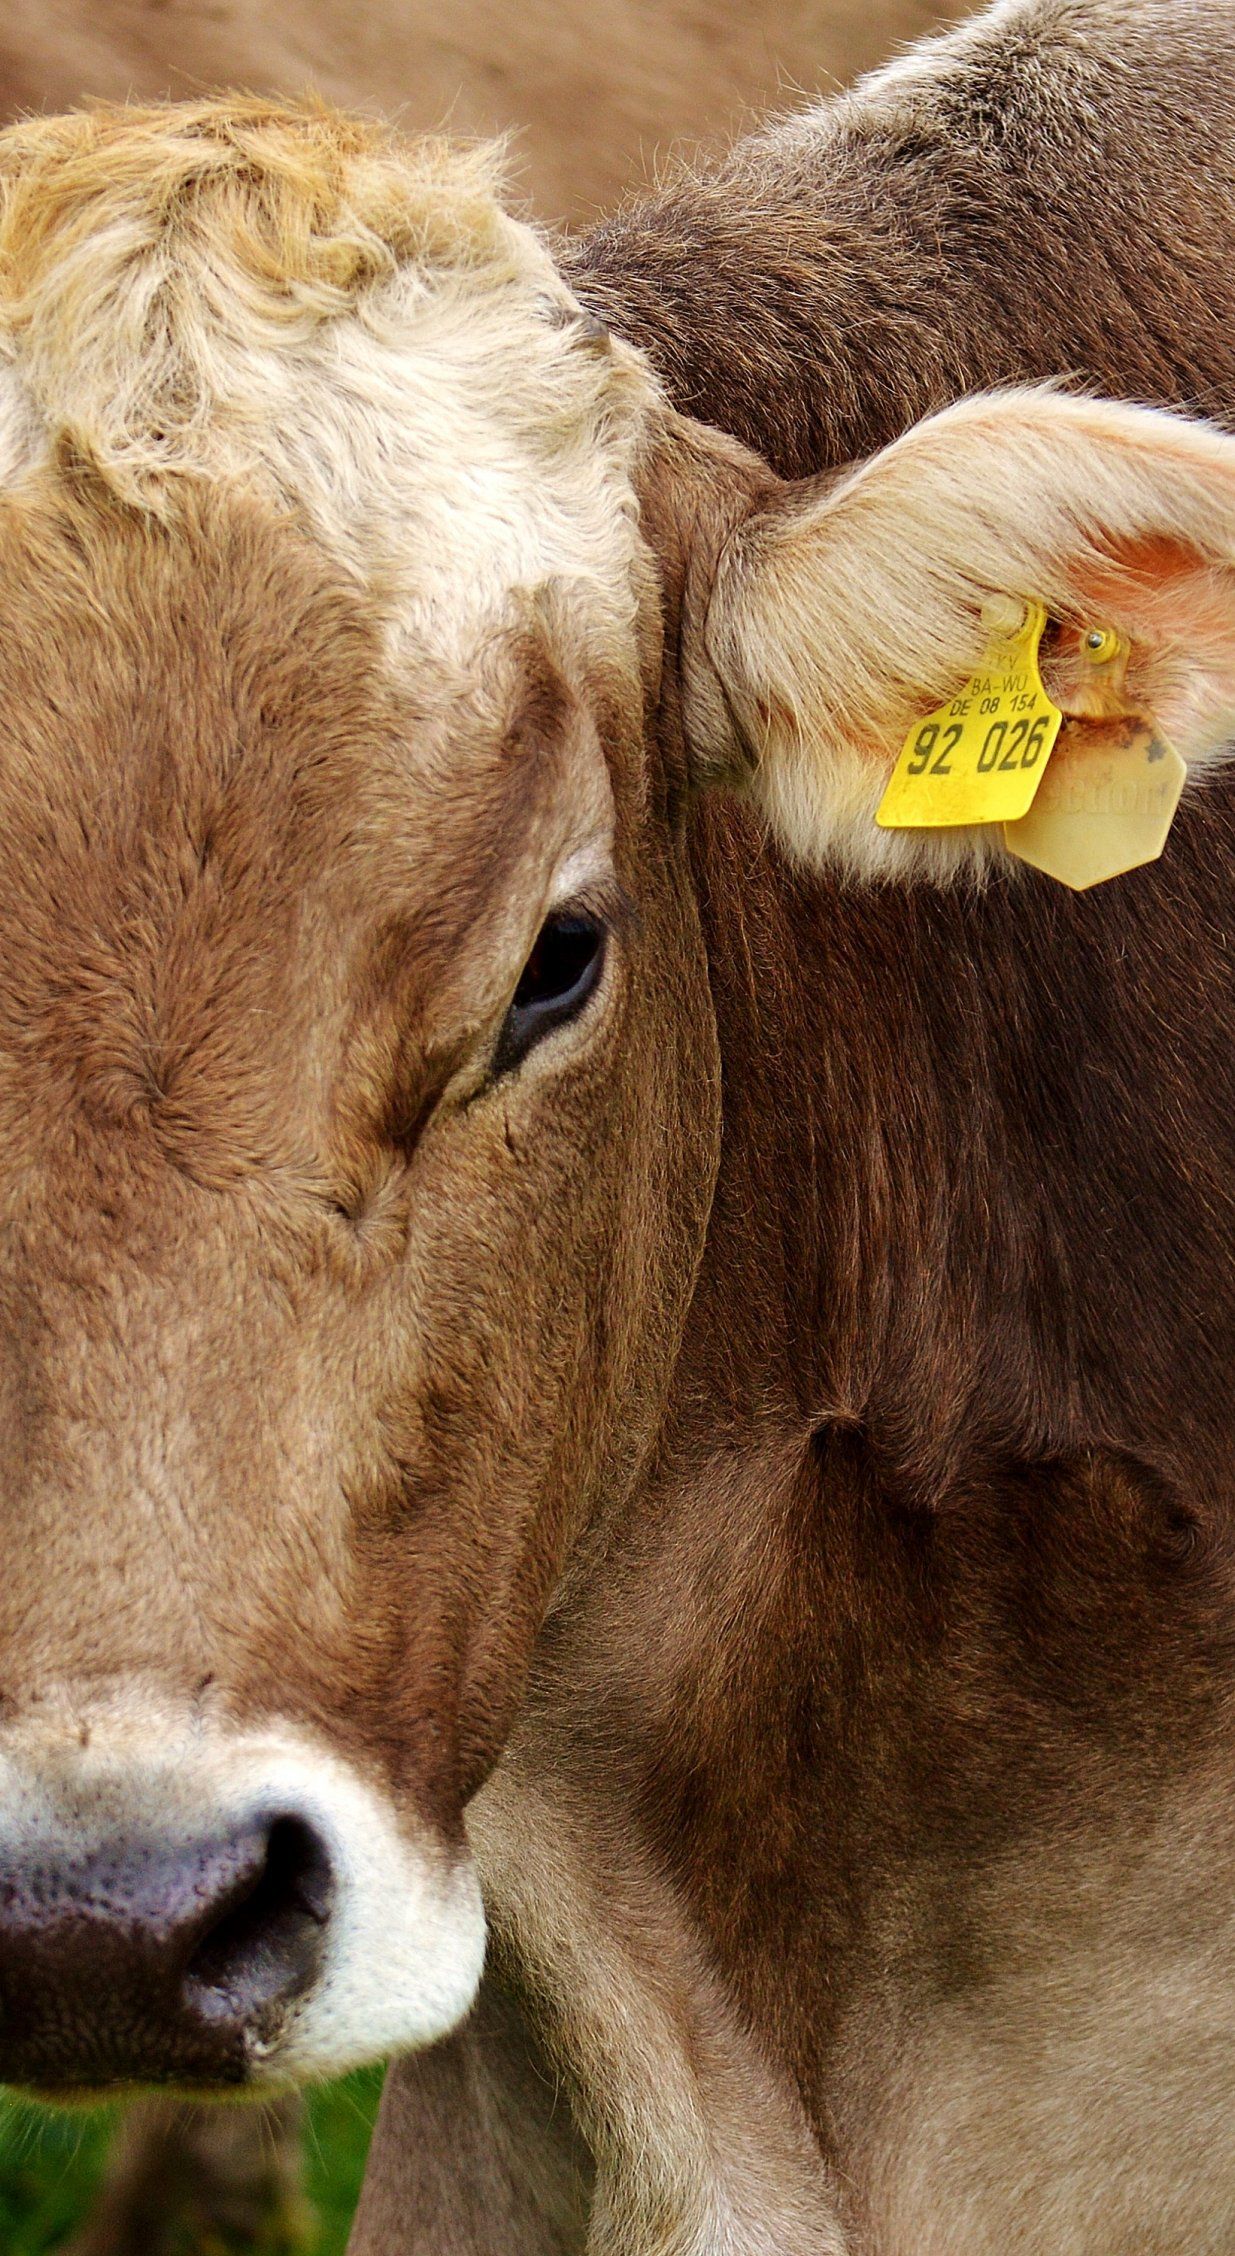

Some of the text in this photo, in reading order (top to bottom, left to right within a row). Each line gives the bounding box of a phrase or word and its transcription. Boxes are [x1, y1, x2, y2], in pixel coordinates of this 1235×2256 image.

[971, 674, 1029, 696] BA-WU
[949, 693, 1038, 717] DE 08 154
[907, 715, 1050, 776] 92 026
